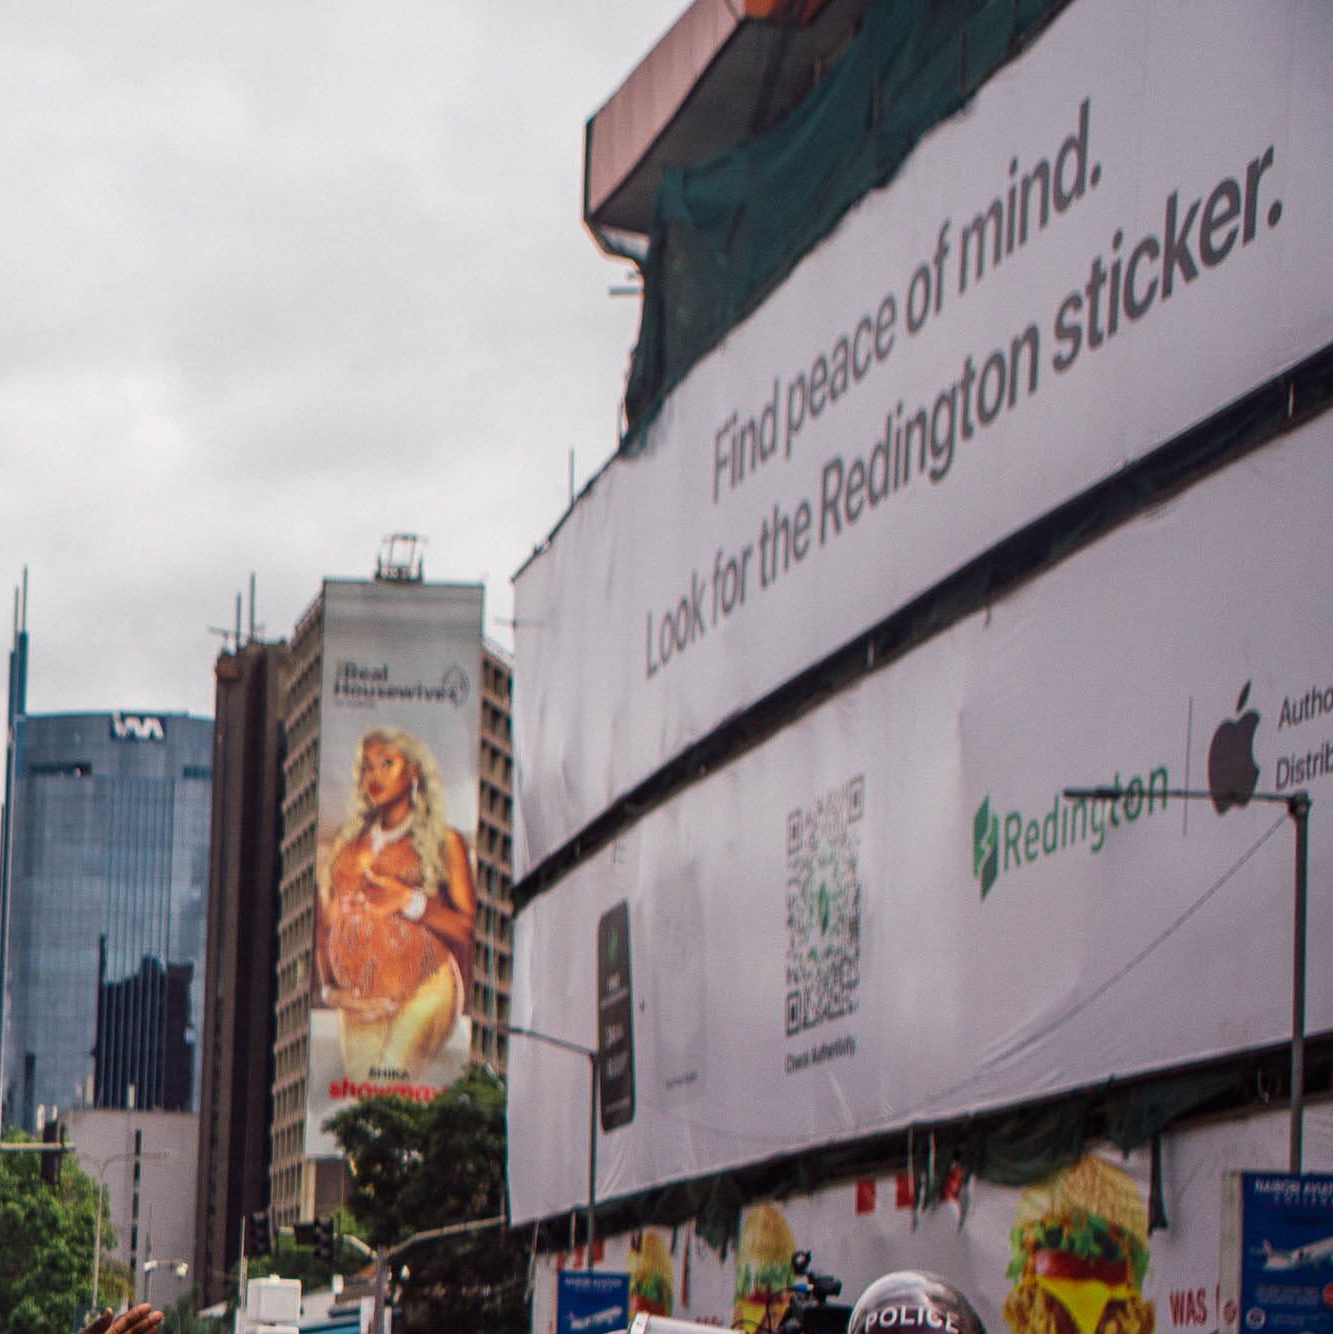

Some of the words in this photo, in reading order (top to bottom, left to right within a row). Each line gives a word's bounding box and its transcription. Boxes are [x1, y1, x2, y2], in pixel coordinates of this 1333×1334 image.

[646, 569, 707, 680] Look
[712, 545, 754, 627] for
[758, 503, 812, 591] the
[819, 324, 1040, 548] Redington
[1052, 144, 1283, 375] sticker.
[712, 375, 781, 504] Find
[785, 292, 897, 461] peace
[905, 216, 952, 337] of
[959, 96, 1102, 296] mind.
[1004, 764, 1168, 872] Redington
[1169, 1286, 1208, 1328] WAS
